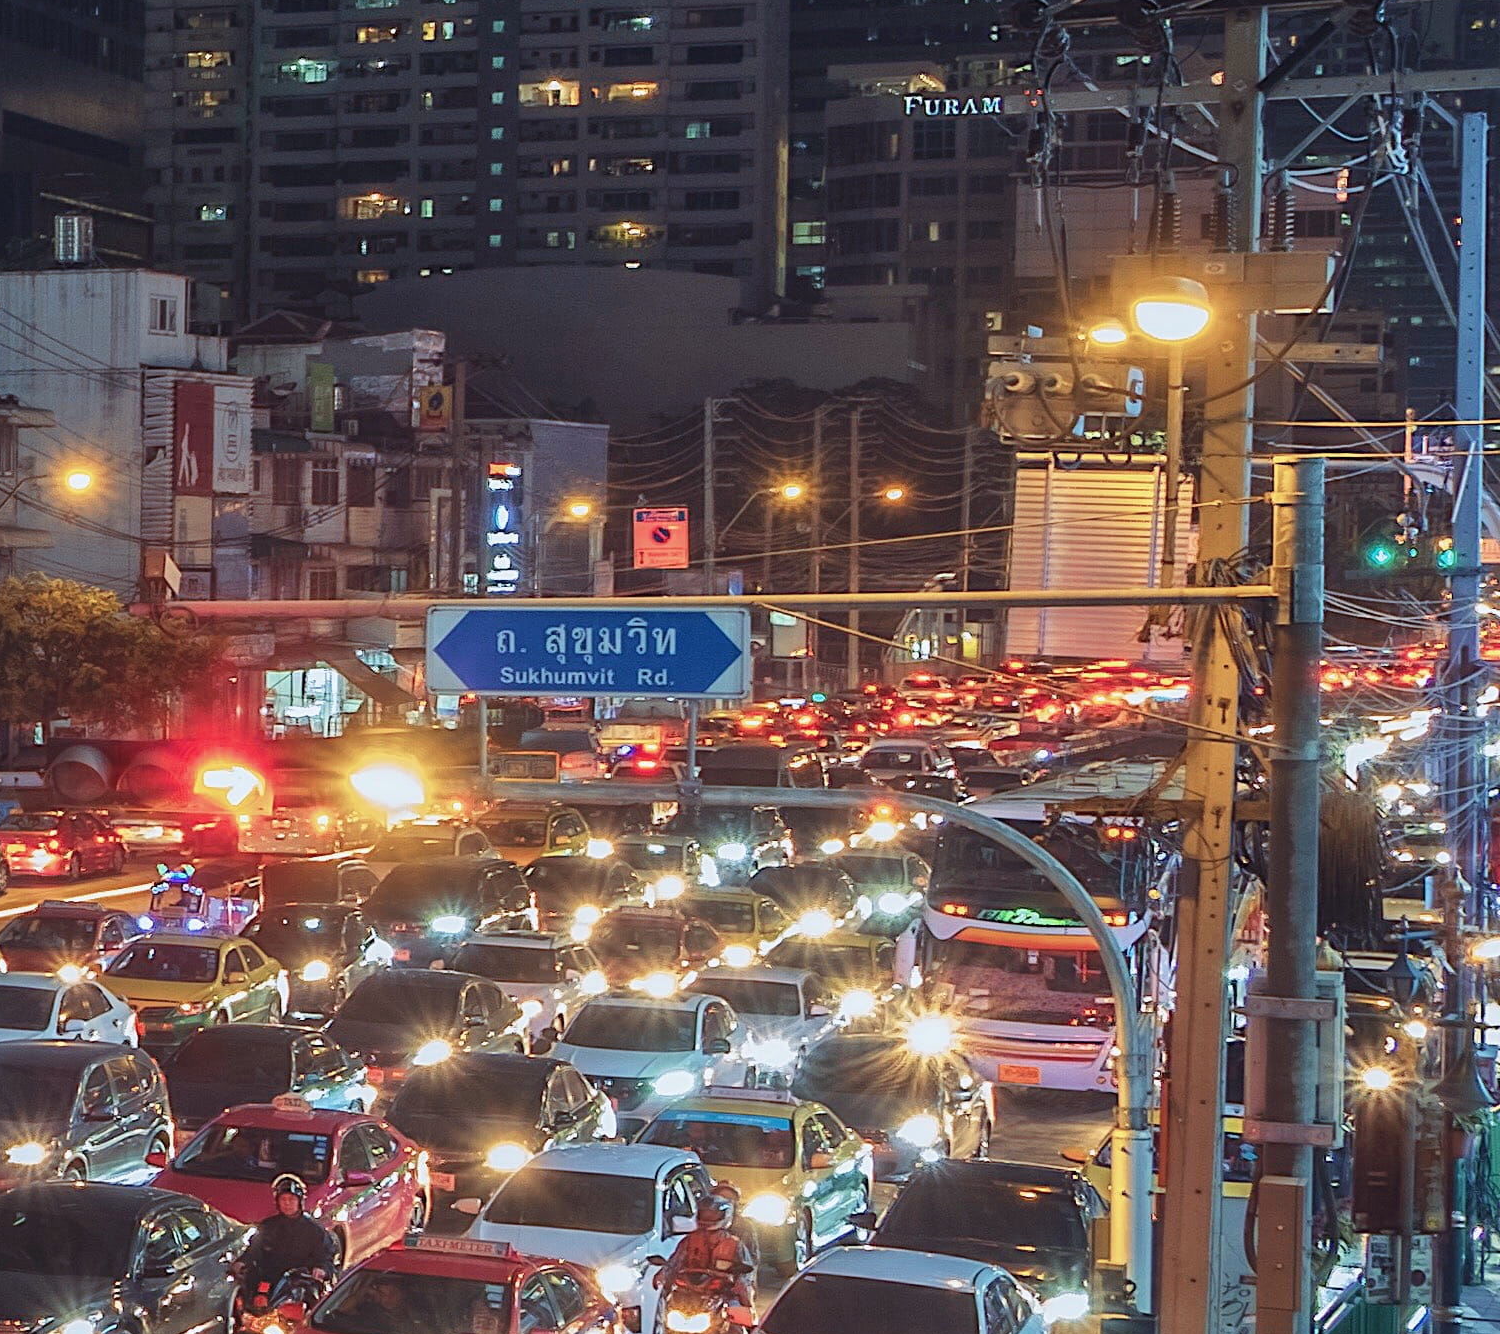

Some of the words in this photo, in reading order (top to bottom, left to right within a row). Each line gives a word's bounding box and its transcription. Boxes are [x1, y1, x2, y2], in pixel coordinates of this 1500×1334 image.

[545, 616, 676, 665] สุขุมวิท
[500, 667, 615, 686] Sukhumvit
[637, 668, 674, 686] Rd.
